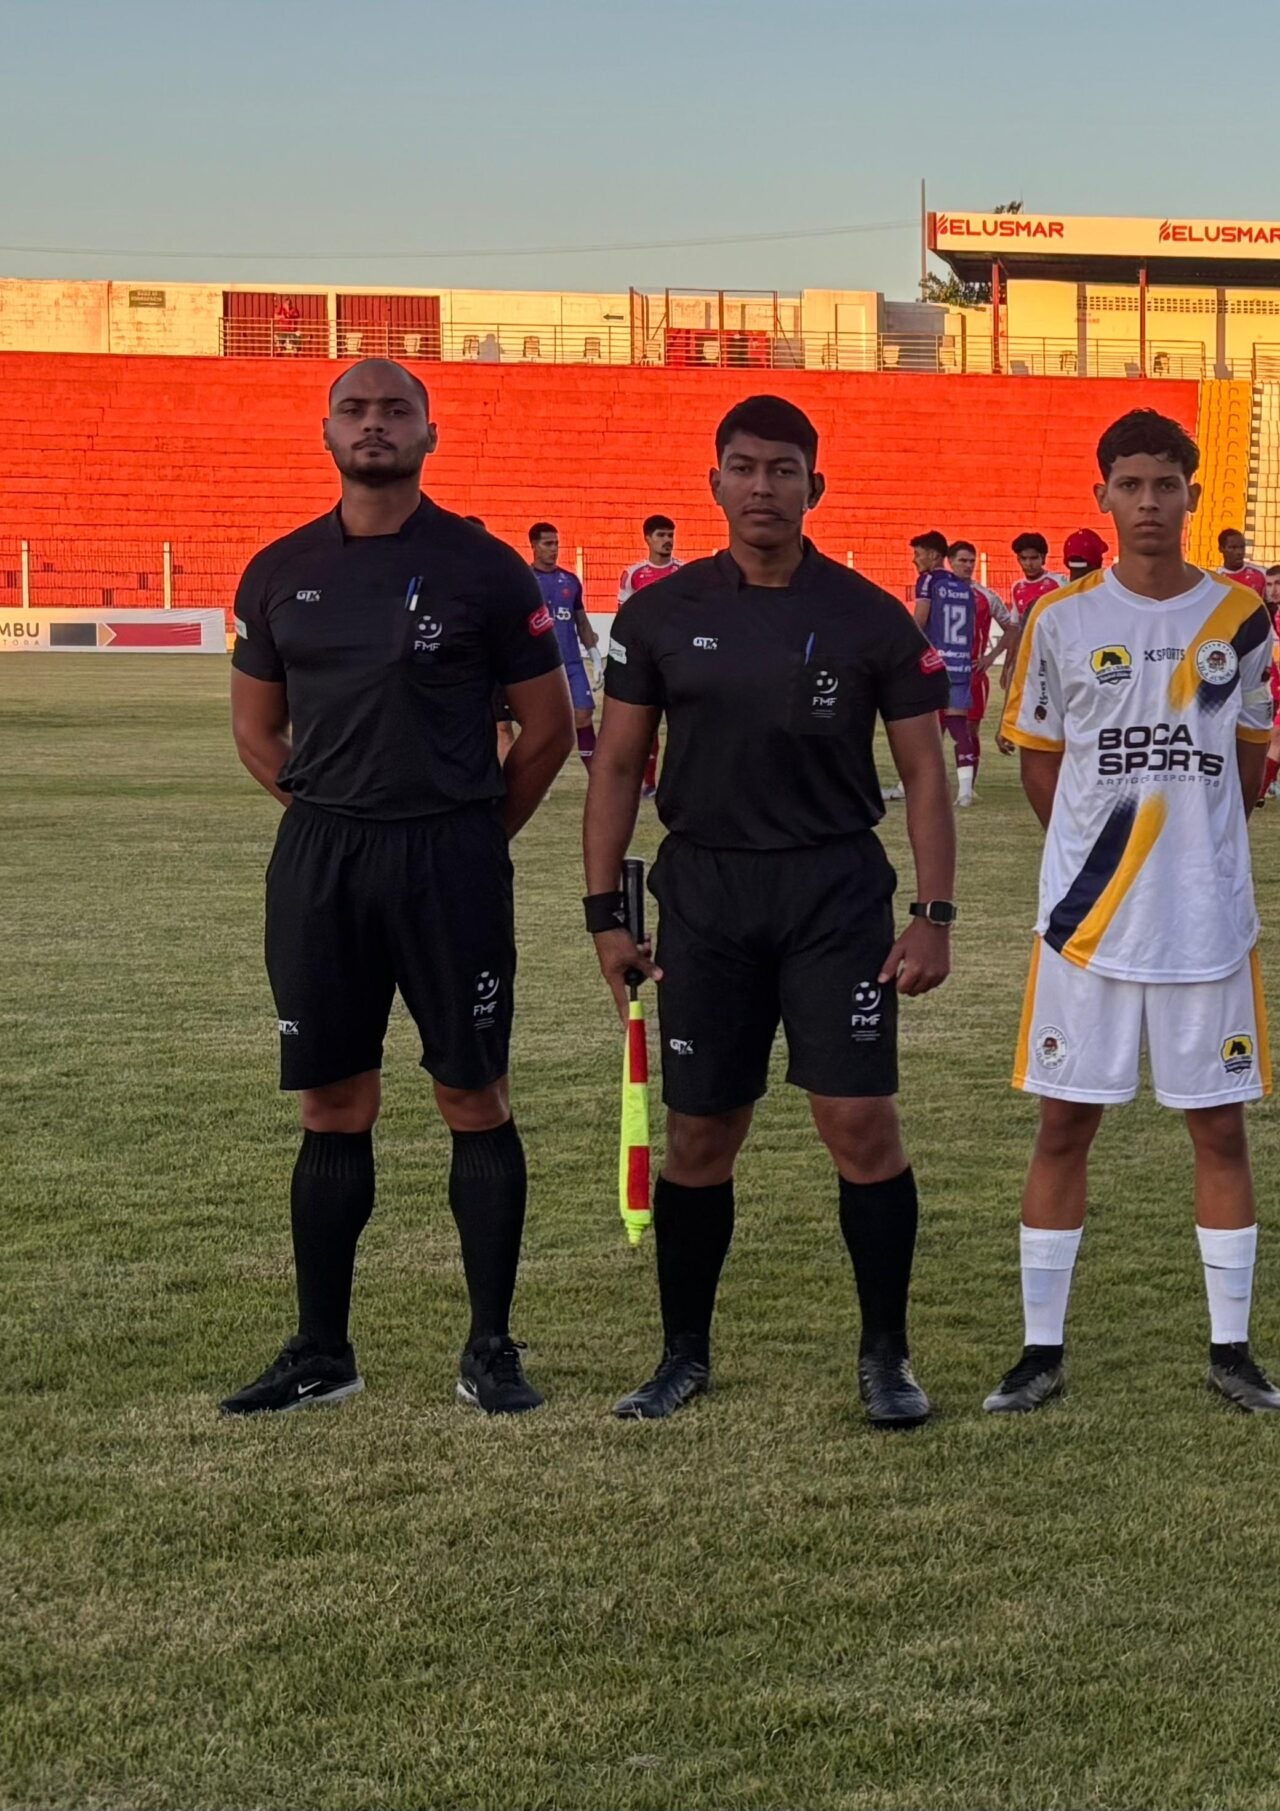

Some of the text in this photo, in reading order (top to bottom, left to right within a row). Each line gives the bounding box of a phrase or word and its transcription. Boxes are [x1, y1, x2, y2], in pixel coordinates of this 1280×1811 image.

[950, 219, 1064, 238] ELUSMAR
[943, 604, 967, 644] 12
[414, 640, 440, 651] FMF
[812, 696, 838, 706] FMF
[1098, 723, 1194, 750] BOCA
[1098, 749, 1224, 777] SPORTS
[473, 1000, 497, 1016] FMF
[851, 1013, 881, 1027] FMF
